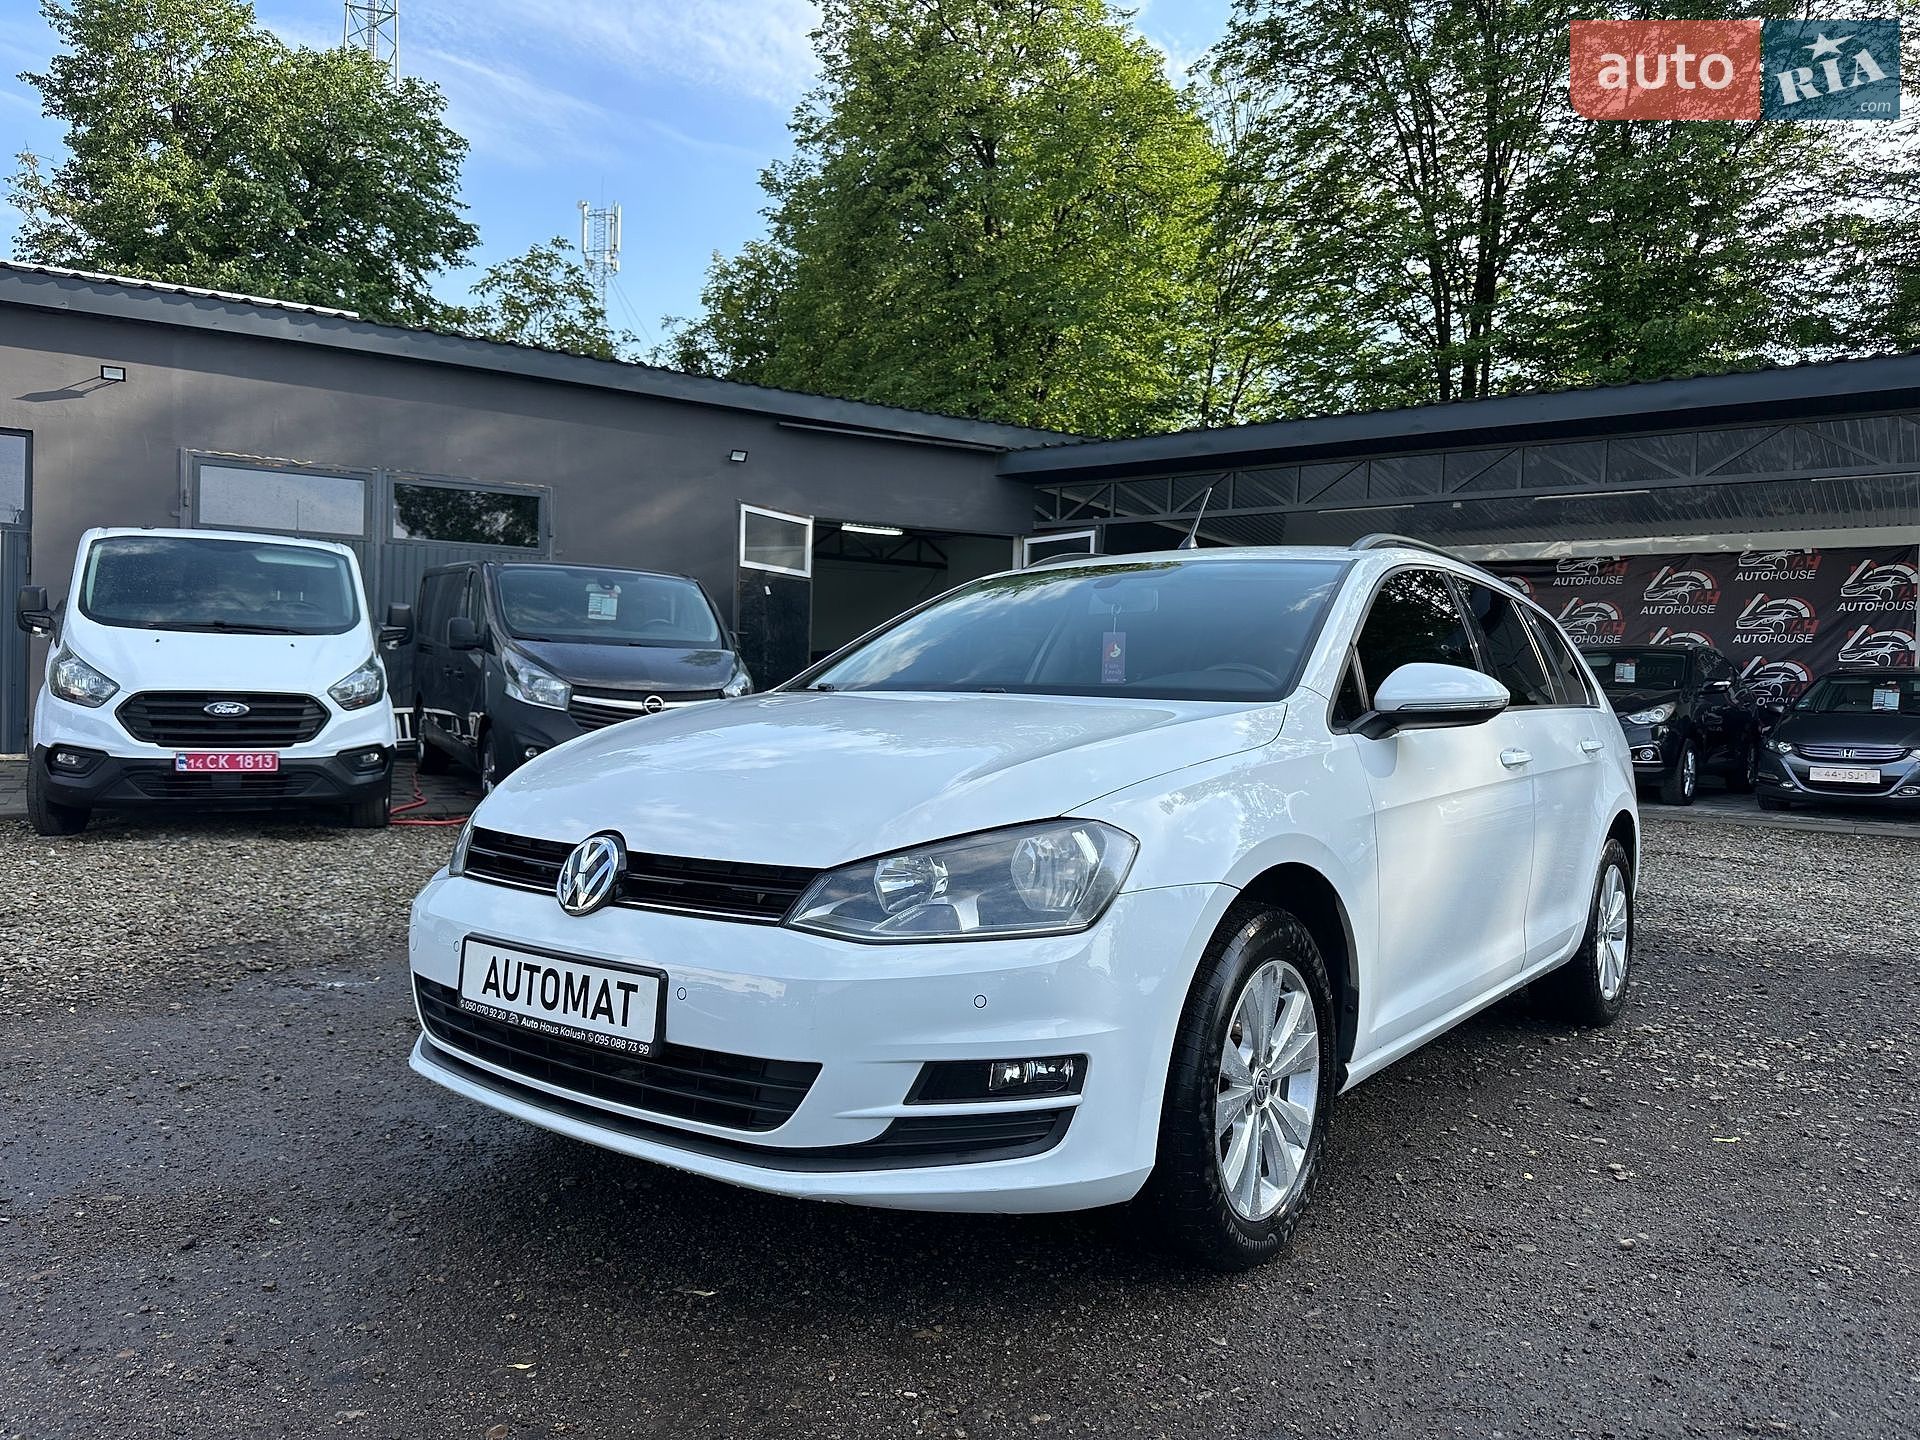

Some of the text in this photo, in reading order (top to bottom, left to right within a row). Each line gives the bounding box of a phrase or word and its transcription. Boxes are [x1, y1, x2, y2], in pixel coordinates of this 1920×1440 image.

[1553, 575, 1624, 586] AUTOHOUSE
[1735, 569, 1817, 581] AUTOHOUSE
[1640, 604, 1717, 615] AUTOHOUSE
[1568, 634, 1622, 645] TOHOUSE
[1732, 633, 1815, 644] AUTOHOUSE
[213, 703, 241, 714] Ford
[188, 754, 273, 769] 14 CK 1813
[481, 955, 639, 1028] AUTOMAT
[465, 1001, 477, 1012] 050
[477, 1004, 489, 1015] 070
[489, 1008, 498, 1017] 92
[498, 1011, 507, 1020] 20
[521, 1017, 539, 1029] Auto
[594, 1033, 609, 1046] 095
[610, 1037, 626, 1049] 088
[627, 1041, 638, 1052] 73
[639, 1043, 650, 1055] 99
